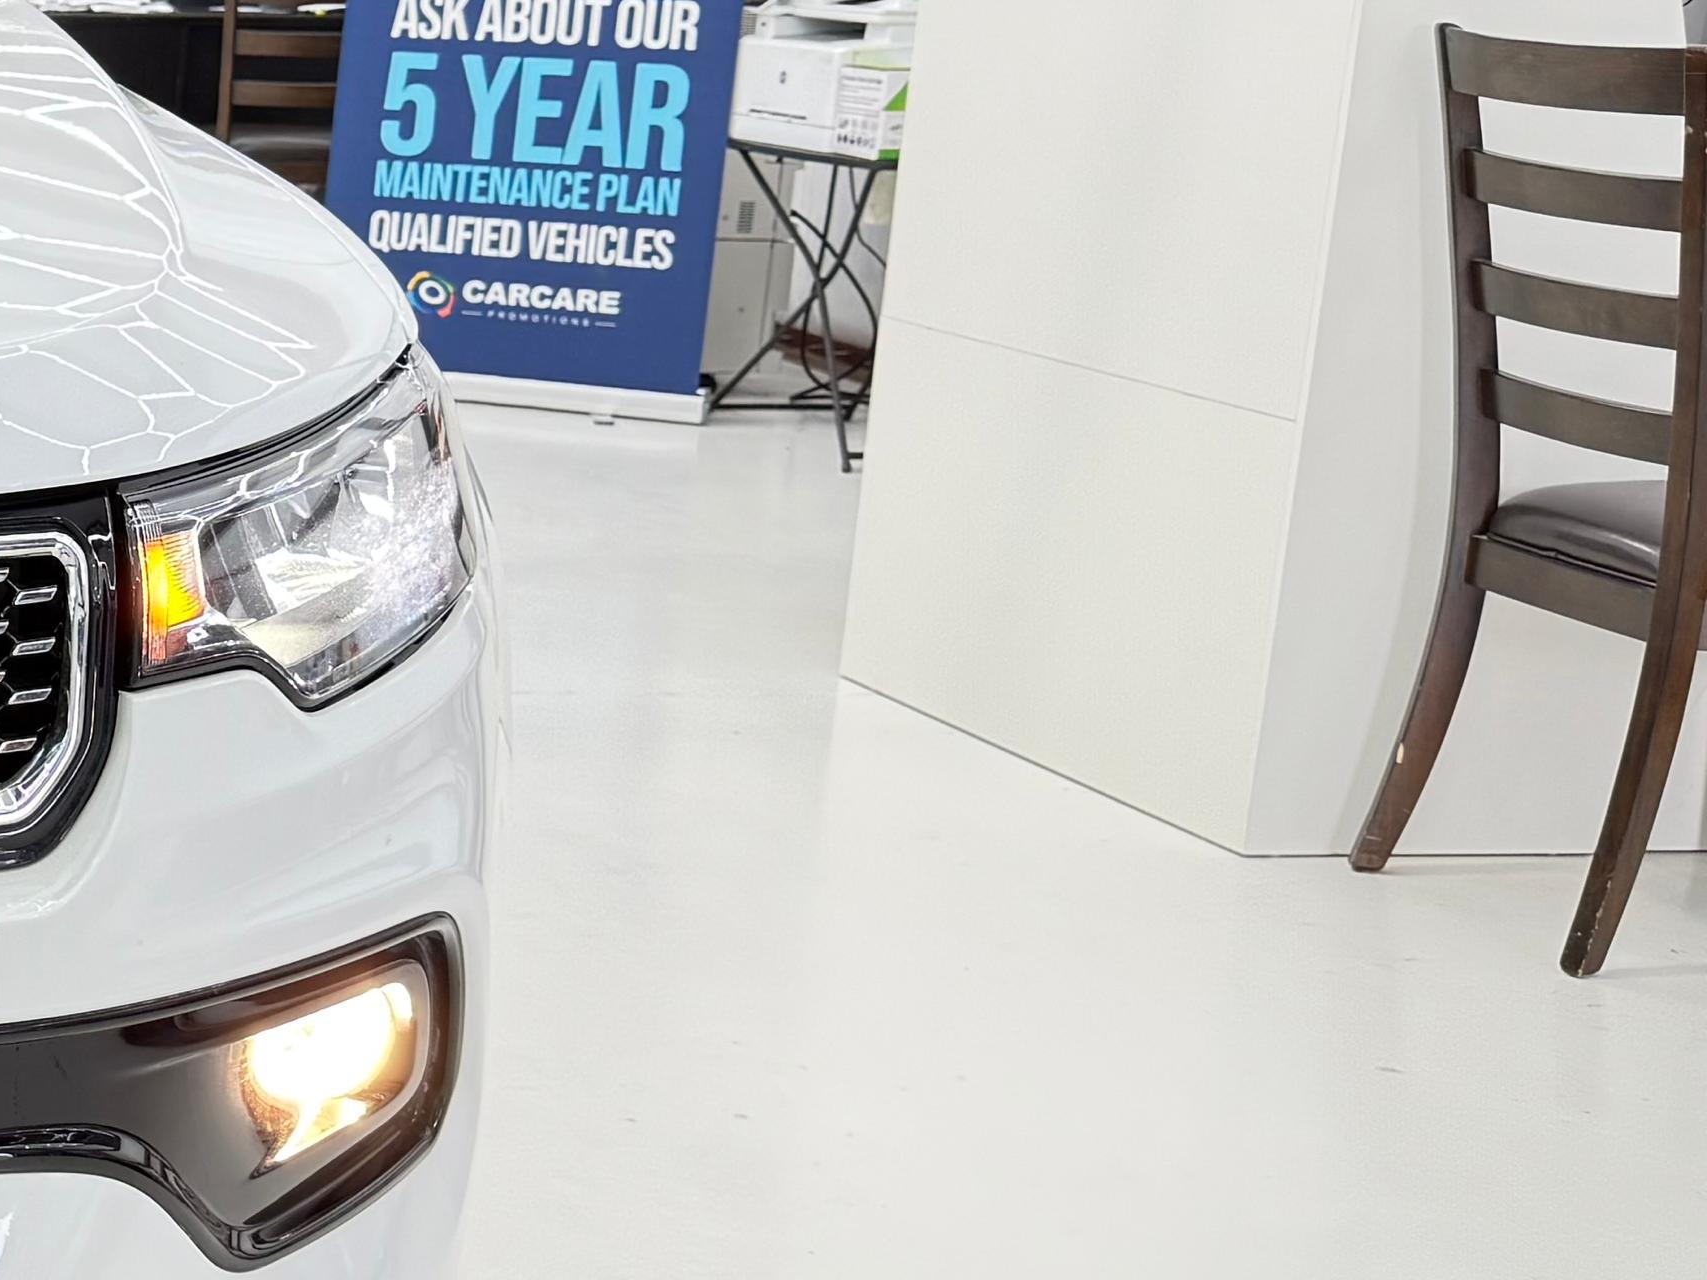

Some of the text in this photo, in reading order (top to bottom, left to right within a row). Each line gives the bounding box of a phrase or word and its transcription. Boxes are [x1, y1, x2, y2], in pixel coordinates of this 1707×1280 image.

[380, 51, 691, 172] 5 YEAR
[373, 159, 682, 217] MAINTENANCE PLAN
[368, 209, 675, 271] QUALIFIED VEHICLES
[461, 279, 622, 315] CARCARE
[487, 310, 590, 328] PROMOTIONS
